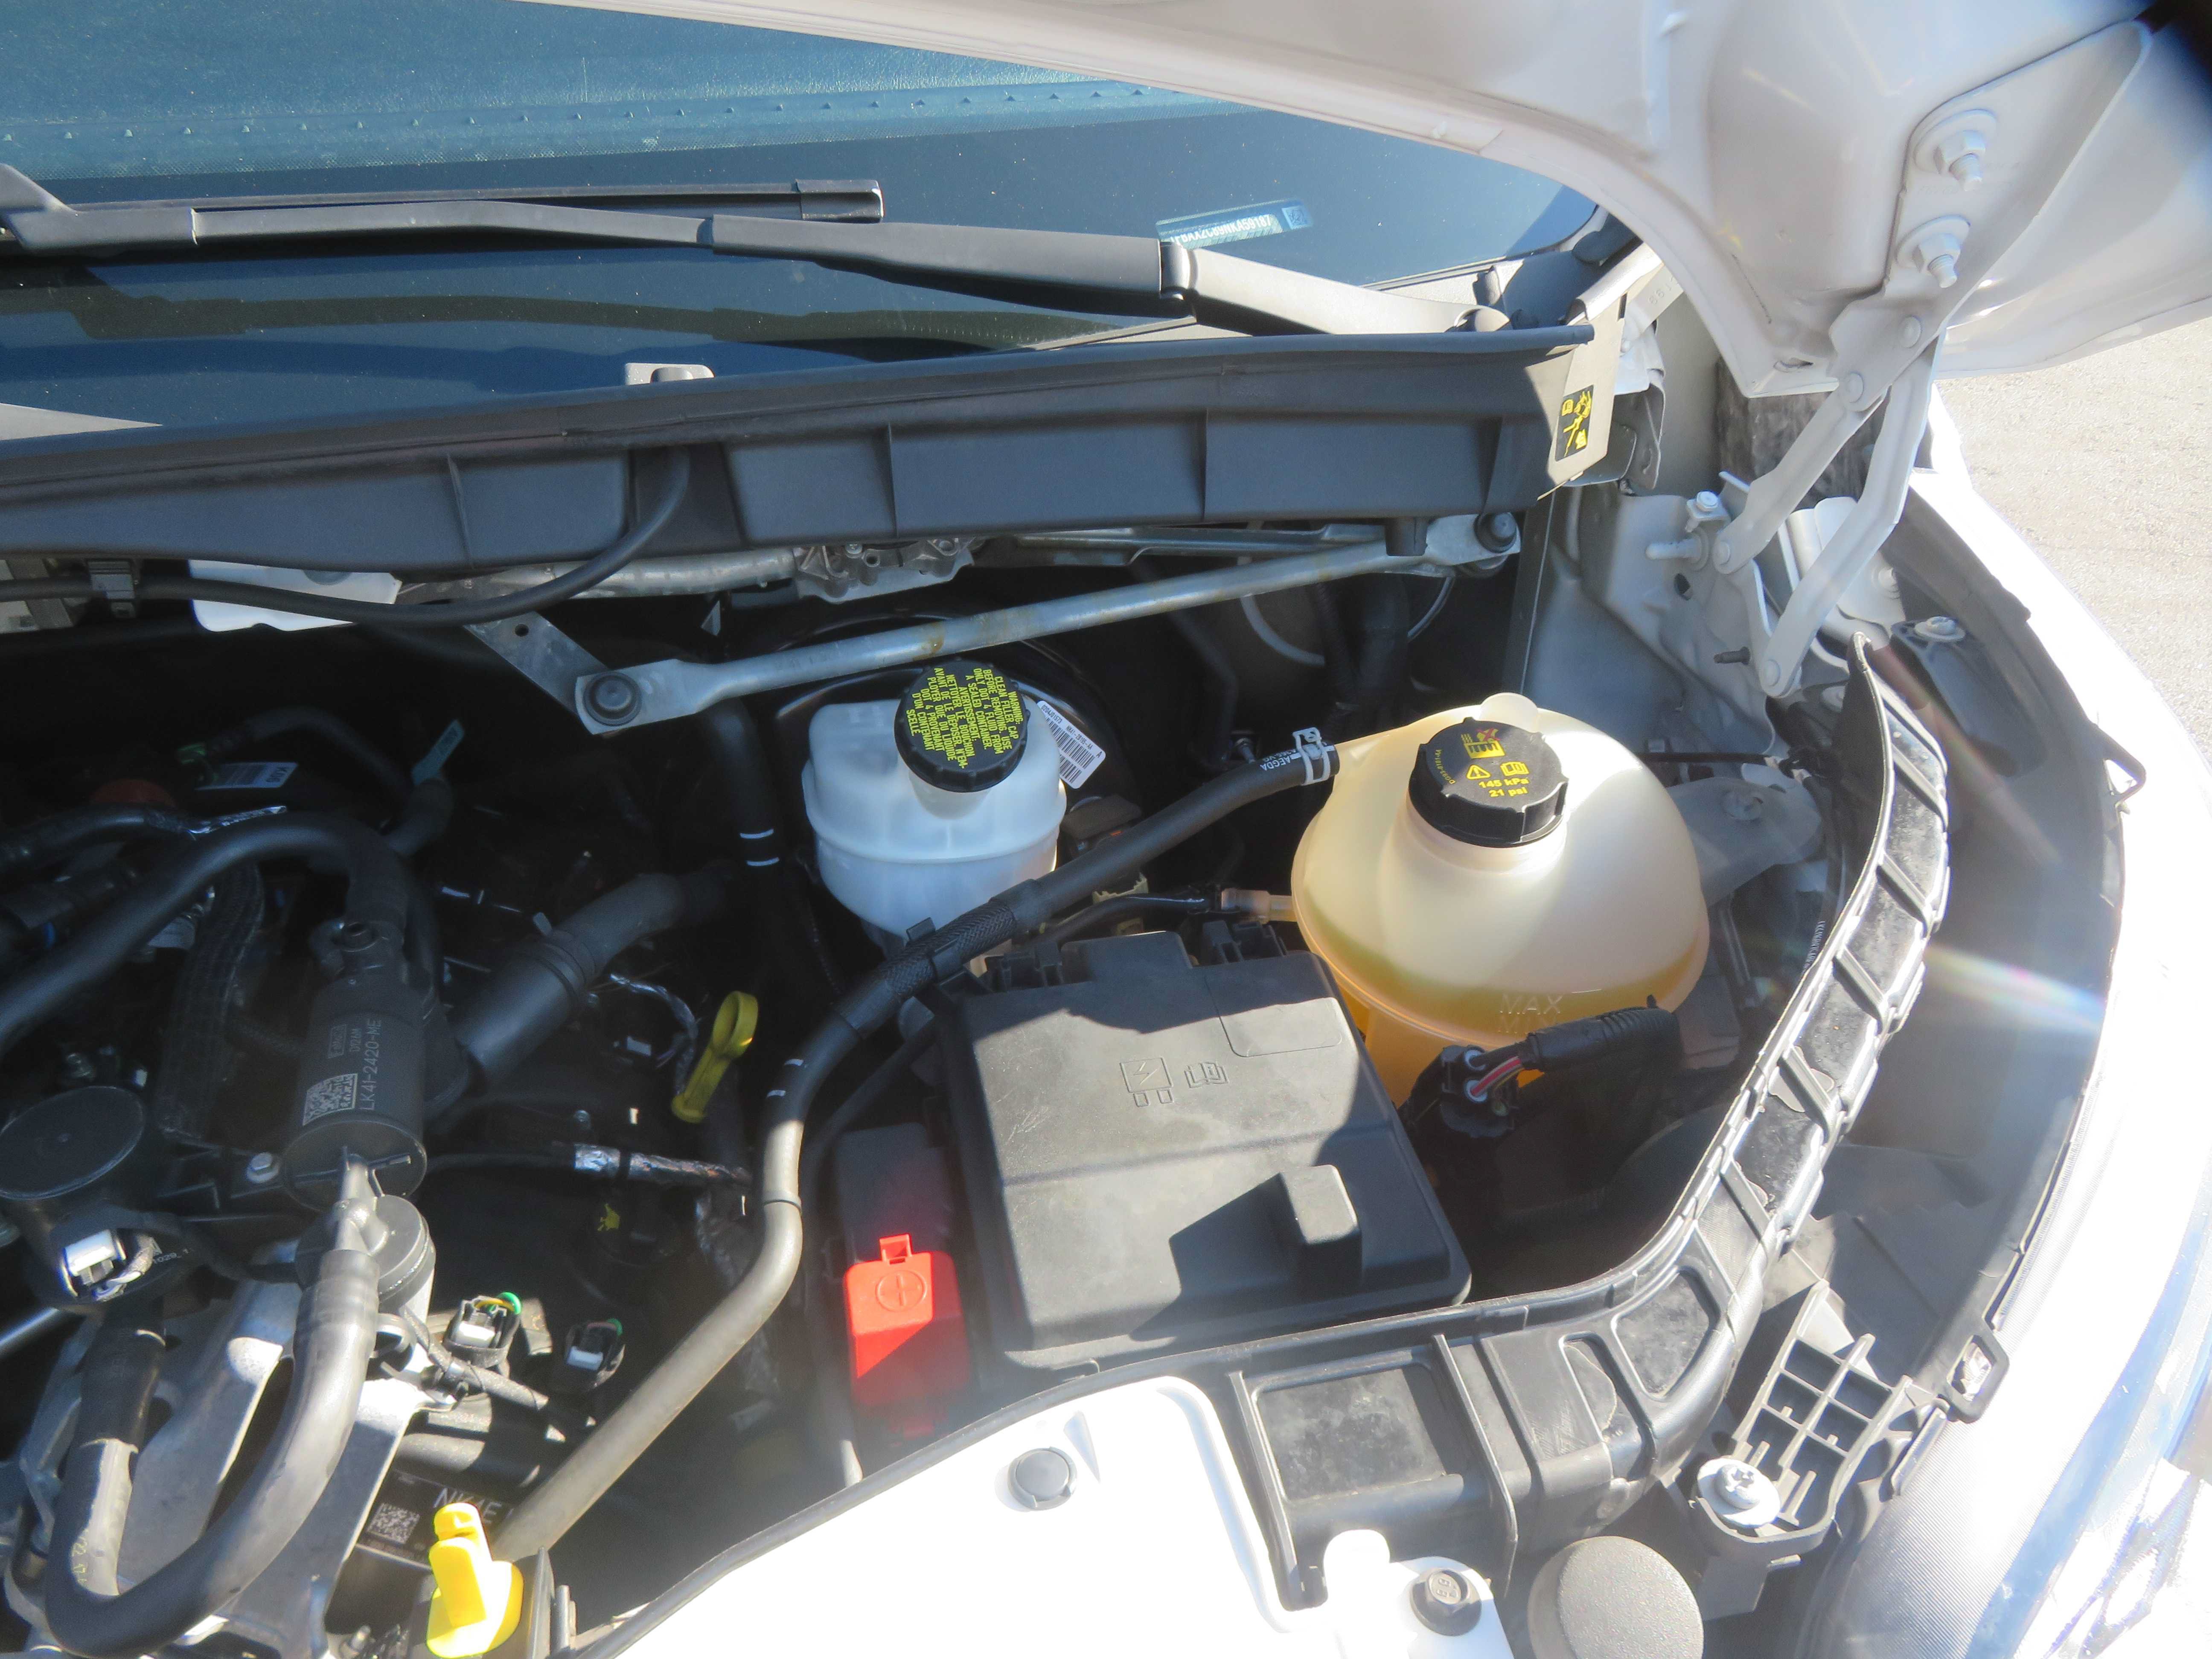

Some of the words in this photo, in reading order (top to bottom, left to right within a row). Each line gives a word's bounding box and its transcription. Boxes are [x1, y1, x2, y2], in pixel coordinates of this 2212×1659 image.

[934, 668, 948, 689] AVANT
[974, 668, 985, 684] ONLY
[994, 676, 1007, 697] CLEAN
[927, 677, 941, 702] PLOYER
[940, 691, 951, 700] DE
[946, 675, 962, 708] NETTOYER
[978, 688, 990, 702] DOT
[934, 705, 946, 719] QUE
[943, 703, 954, 712] LE
[956, 711, 966, 720] LE
[959, 687, 980, 741] AVERTISSEMENT:
[968, 683, 982, 708] SEALED
[975, 710, 992, 749] CONTAINER.
[983, 669, 997, 694] BEFORE
[991, 697, 1007, 733] REMOVING.
[1001, 736, 1012, 750] USE
[1000, 701, 1014, 723] FILLER
[1008, 691, 1023, 724] WARNING:
[920, 688, 931, 701] DOT
[926, 712, 945, 751] PROVENANT
[938, 721, 949, 731] DU
[985, 712, 998, 732] FLUID
[917, 712, 935, 750] CONTENANT
[959, 724, 975, 757] BOUCHON
[1007, 726, 1019, 739] CAP
[941, 733, 957, 761] LIQUIDE
[991, 734, 1004, 754] FROM
[1479, 779, 1502, 788] 145
[1504, 778, 1529, 786] kPa
[1489, 789, 1505, 797] 21
[1508, 787, 1528, 797] psi
[1499, 993, 1563, 1015] MAX
